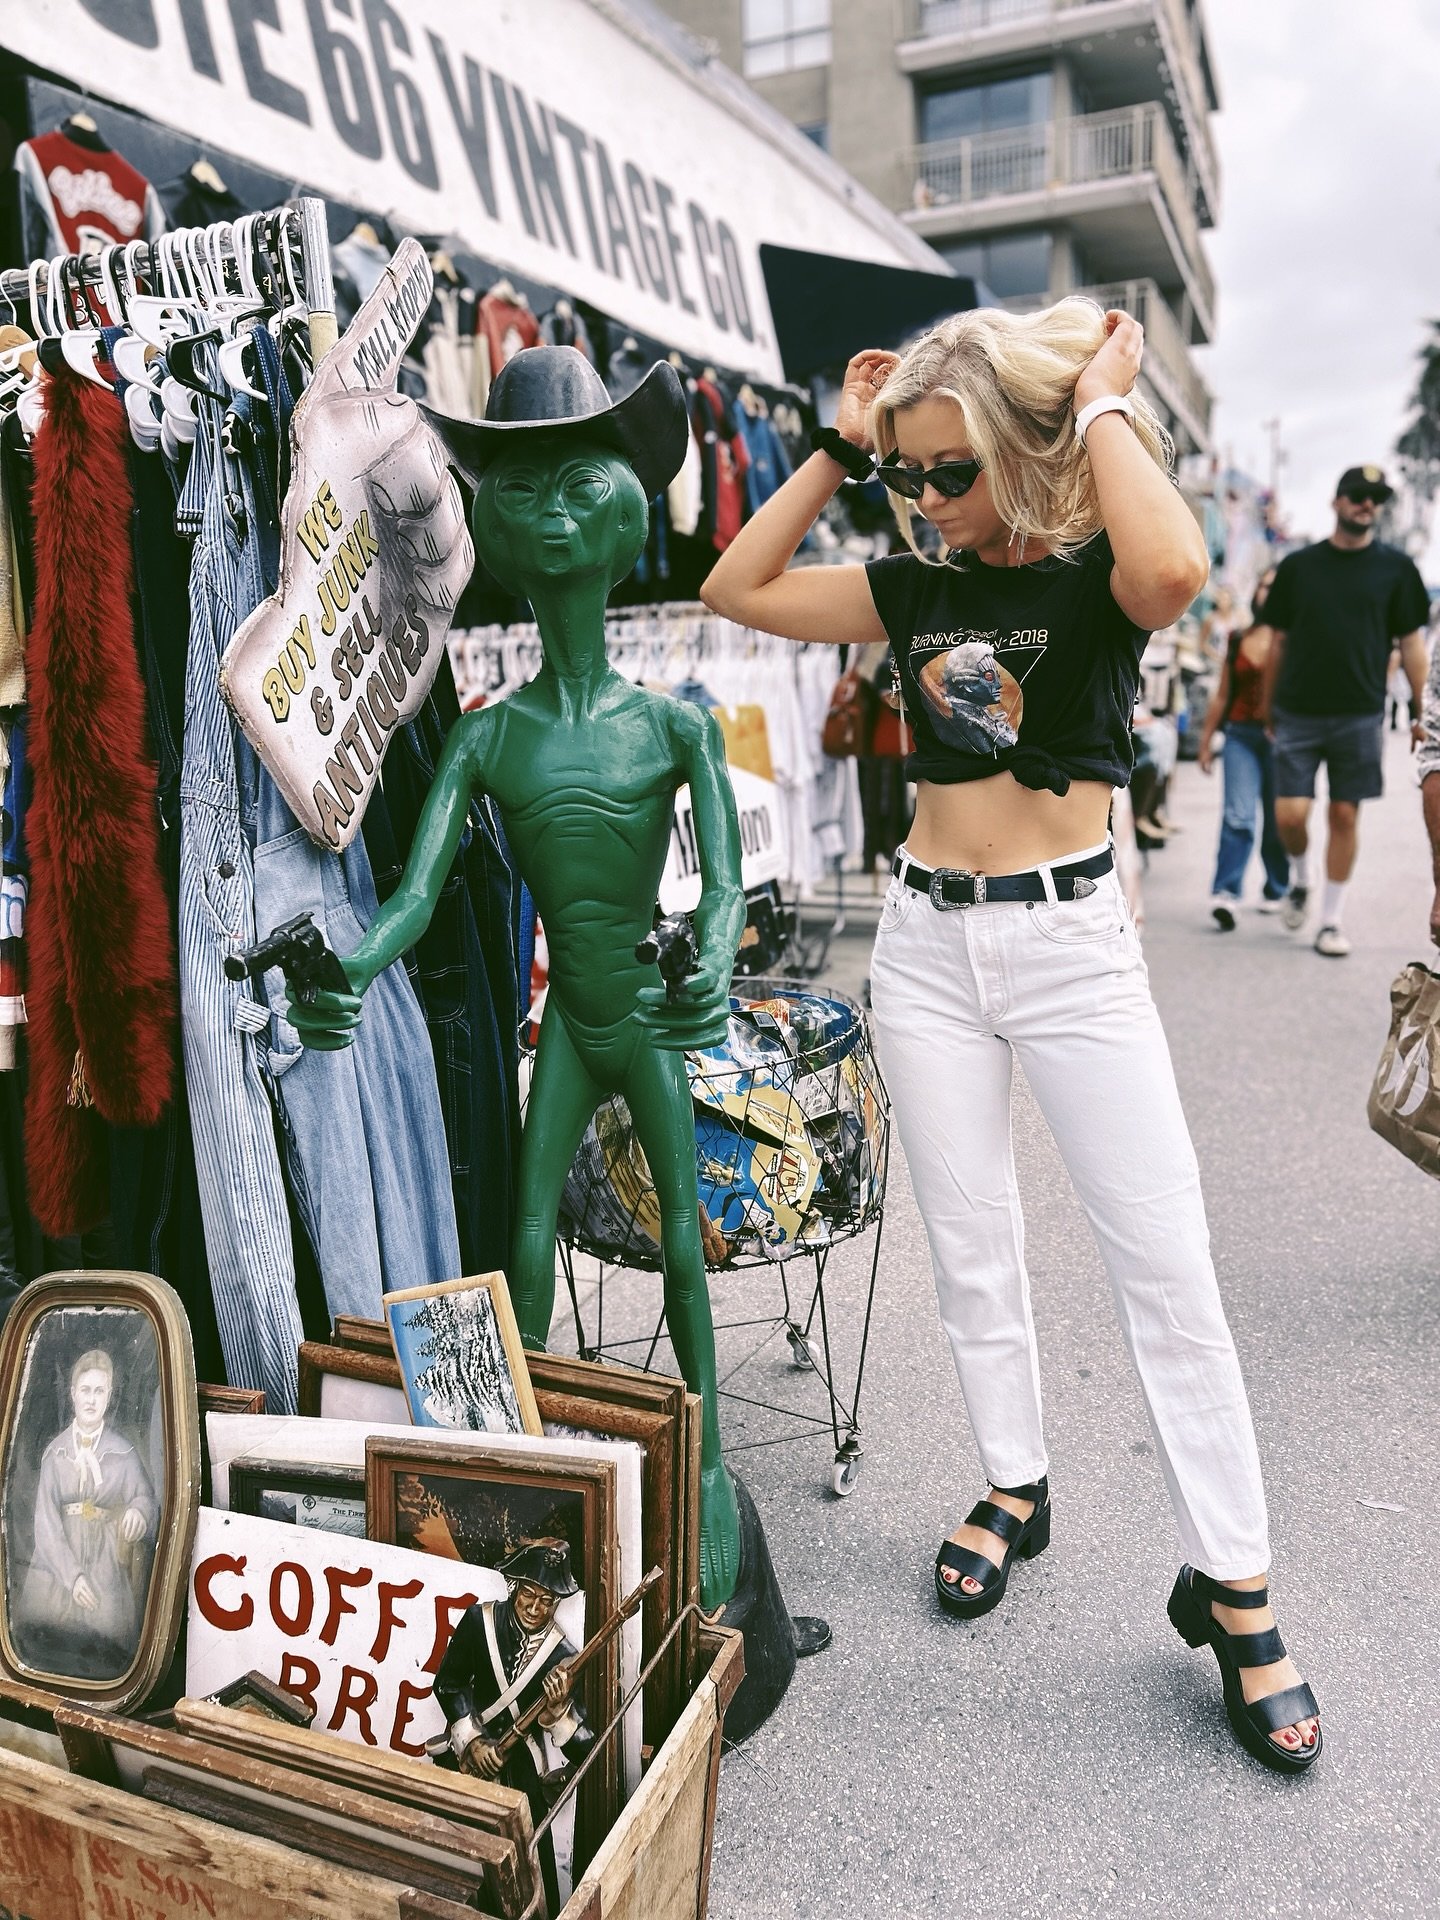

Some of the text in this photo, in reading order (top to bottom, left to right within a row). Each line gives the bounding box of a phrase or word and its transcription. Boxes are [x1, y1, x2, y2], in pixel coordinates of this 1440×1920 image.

[424, 25, 698, 317] VINTAGE
[297, 480, 343, 563] WE
[262, 510, 381, 723] BUY JUNK
[311, 594, 383, 735] & SELL
[312, 593, 430, 846] ANTIQUES
[136, 1857, 217, 1918] SON
